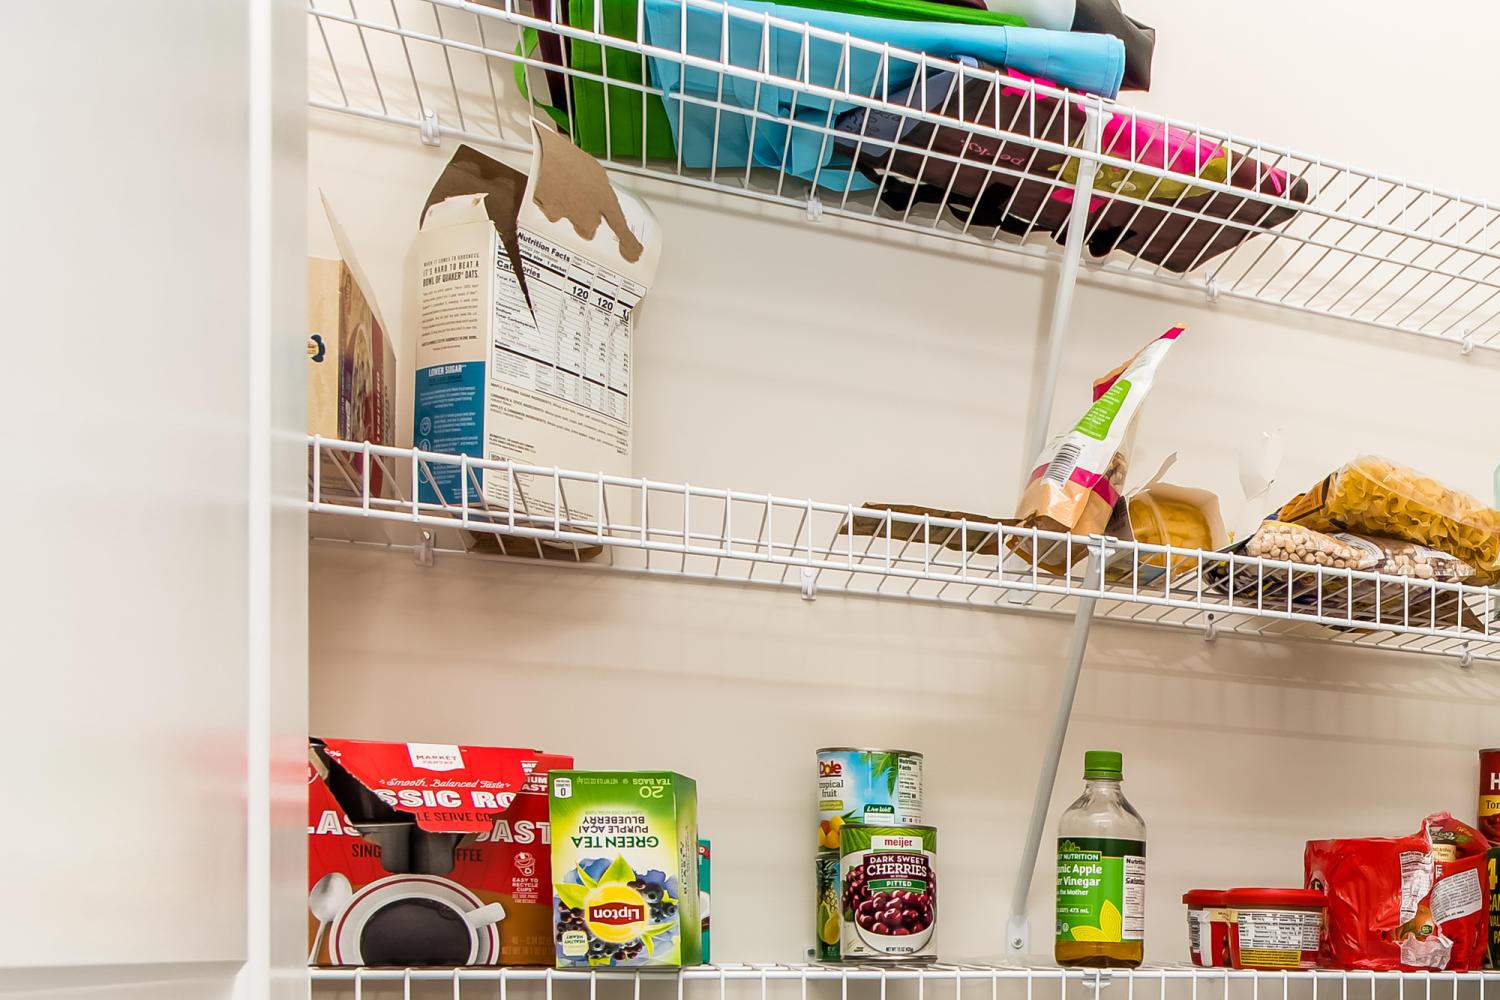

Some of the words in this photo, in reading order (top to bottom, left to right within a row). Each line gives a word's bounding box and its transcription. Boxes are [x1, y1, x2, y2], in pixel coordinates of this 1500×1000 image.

[518, 232, 549, 252] Nutrition
[551, 248, 570, 262] Facts
[572, 286, 589, 299] 120
[598, 297, 614, 311] 120
[819, 761, 842, 776] Dole
[432, 778, 478, 788] Balanced
[480, 780, 505, 788] Taste
[632, 778, 654, 786] BAGS
[656, 778, 671, 786] TEA
[639, 786, 664, 799] 20
[821, 788, 839, 798] fruit
[583, 815, 645, 824] BLUEBERRY
[614, 825, 648, 834] PURPLE
[572, 836, 606, 848] TEA
[611, 836, 660, 848] GREEN
[884, 836, 913, 847] meijer
[870, 857, 893, 865] DARK
[896, 855, 925, 865] SWEET
[866, 864, 927, 877] CHERRIES
[1072, 864, 1102, 876] Apple
[886, 880, 912, 888] PITTED
[1063, 877, 1101, 888] Vinegar
[593, 904, 641, 920] Lipton
